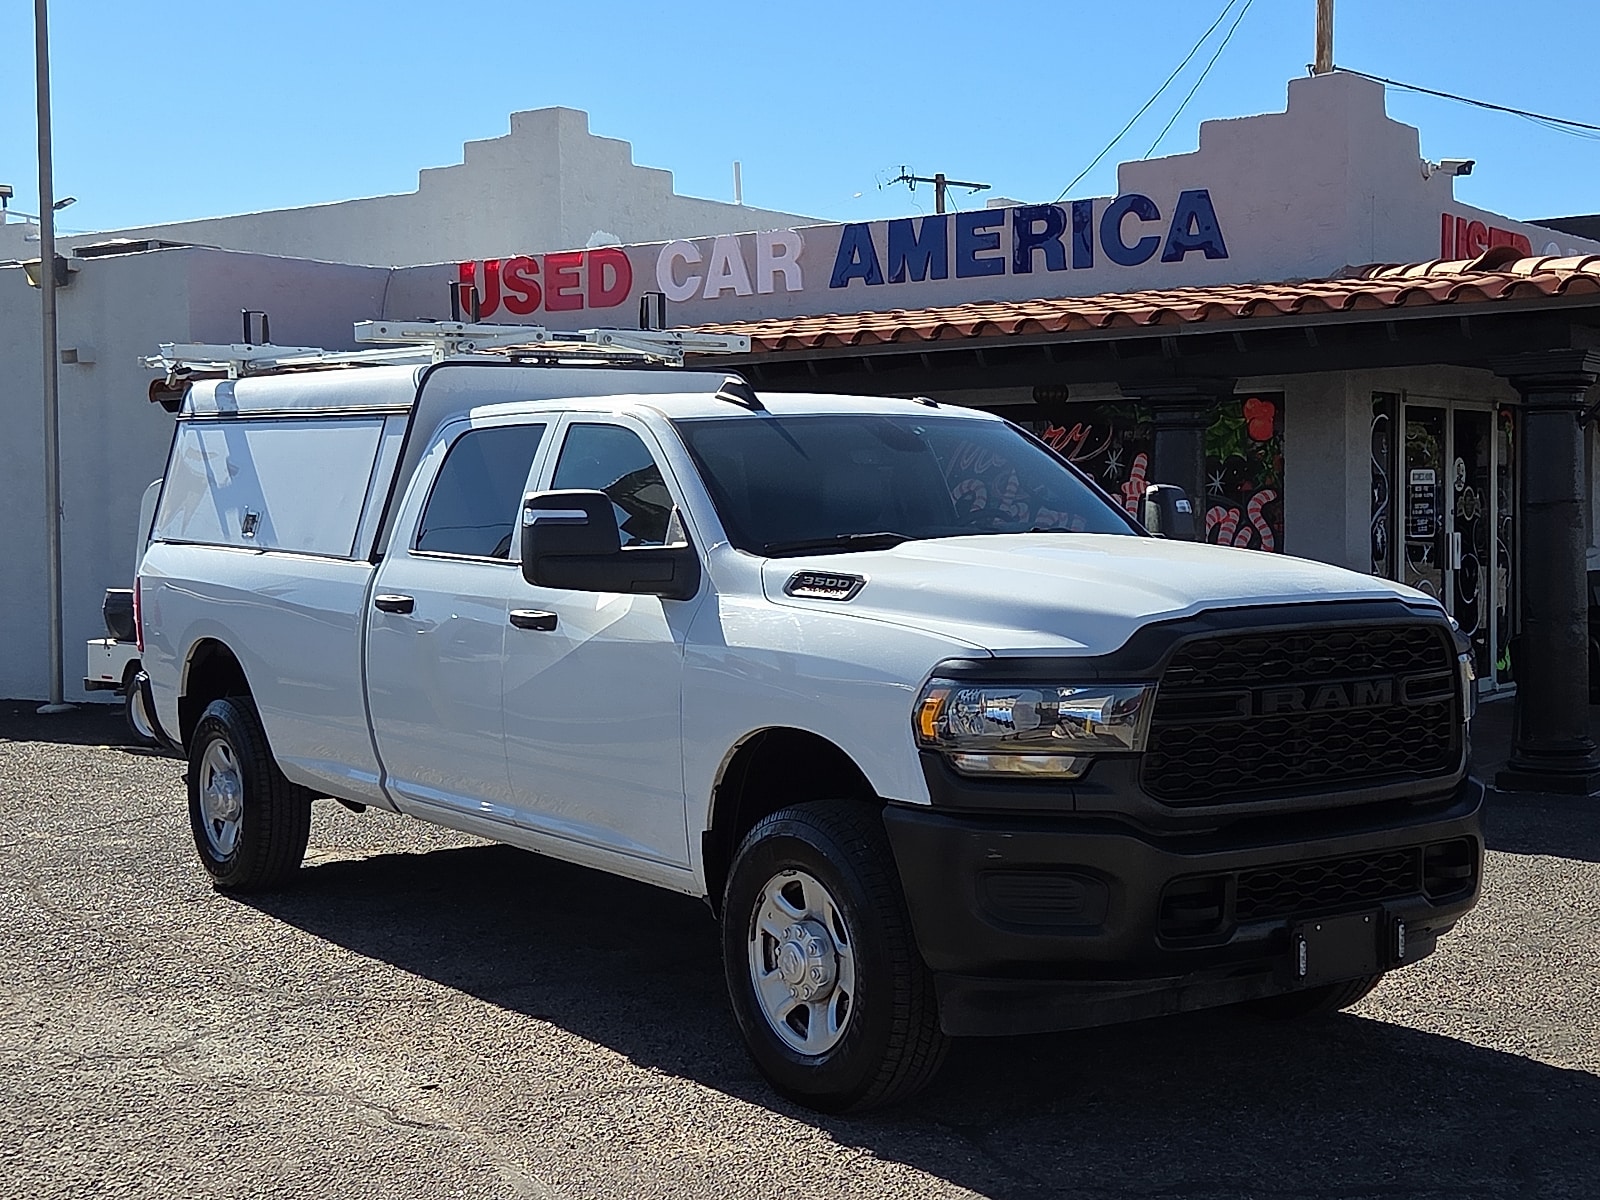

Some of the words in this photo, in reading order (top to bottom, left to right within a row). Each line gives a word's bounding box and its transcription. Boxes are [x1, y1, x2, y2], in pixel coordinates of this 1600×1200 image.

[459, 247, 633, 319] USED
[655, 231, 804, 302] CAR
[828, 189, 1230, 289] AMERICA
[802, 576, 851, 588] 3500
[1262, 678, 1393, 715] RAM
